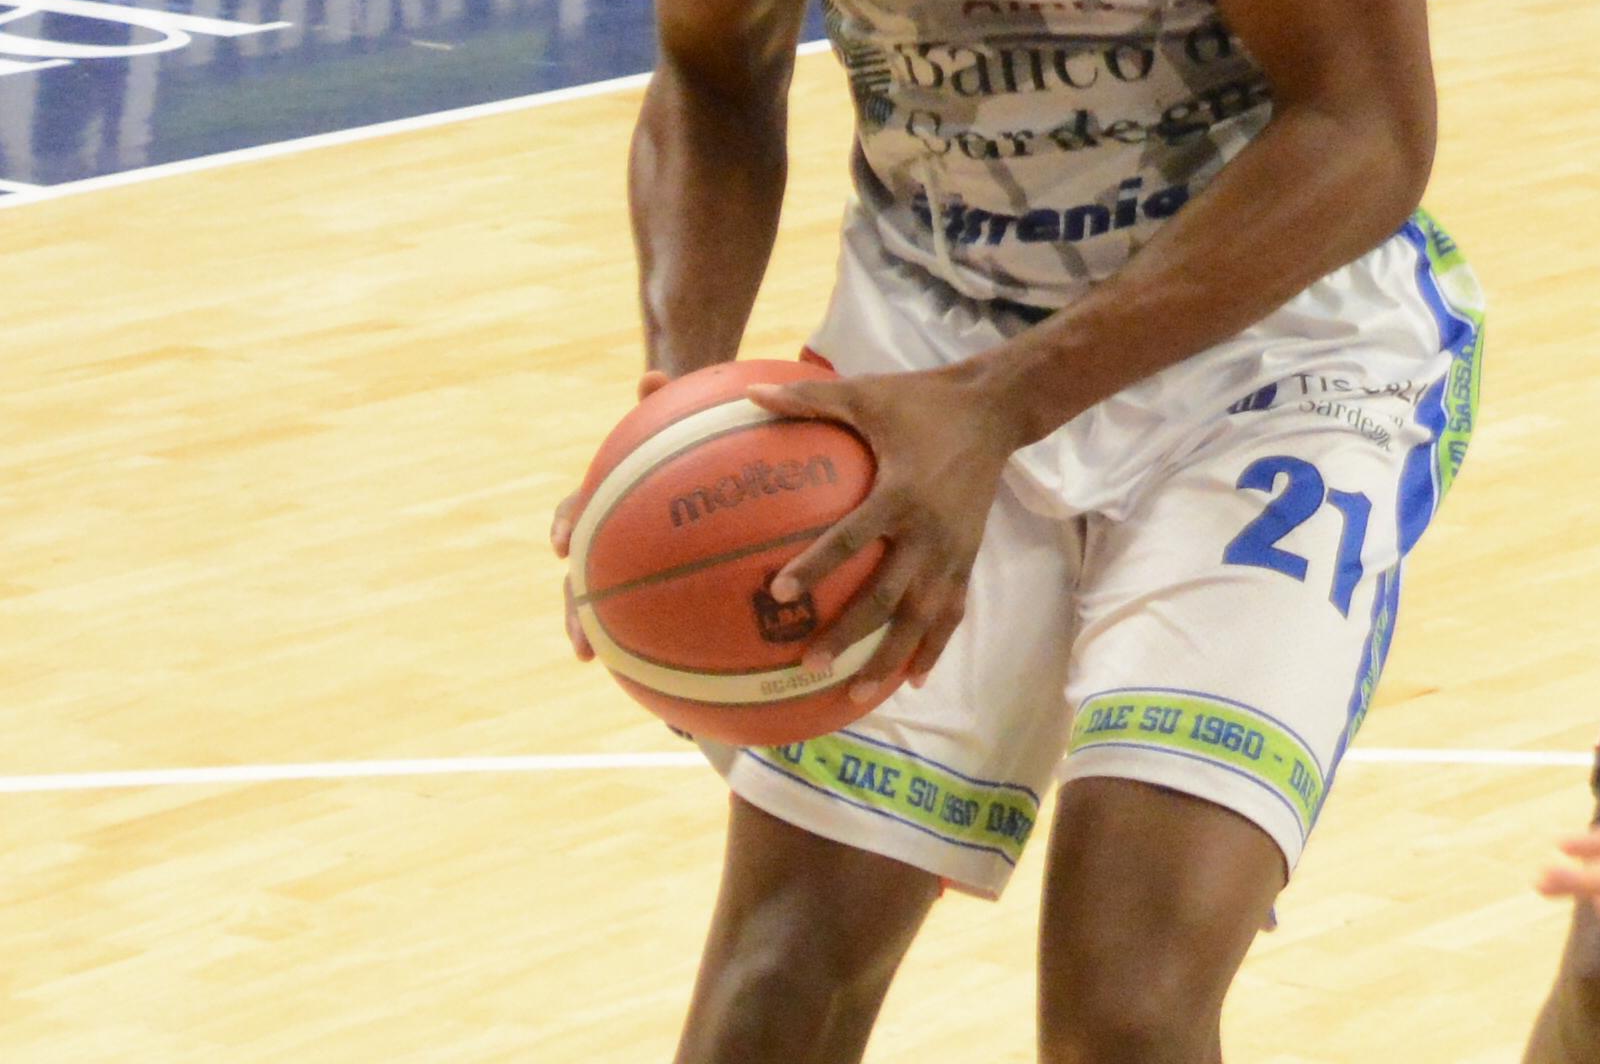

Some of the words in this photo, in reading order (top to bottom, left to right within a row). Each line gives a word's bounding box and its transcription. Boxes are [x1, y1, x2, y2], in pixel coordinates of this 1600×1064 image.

[668, 456, 838, 528] molten
[1222, 455, 1372, 619] 21
[1084, 705, 1134, 733] DAE
[1139, 706, 1182, 734] SU
[1189, 714, 1264, 761] 1960
[837, 753, 899, 799] DAE
[906, 776, 938, 813] SU
